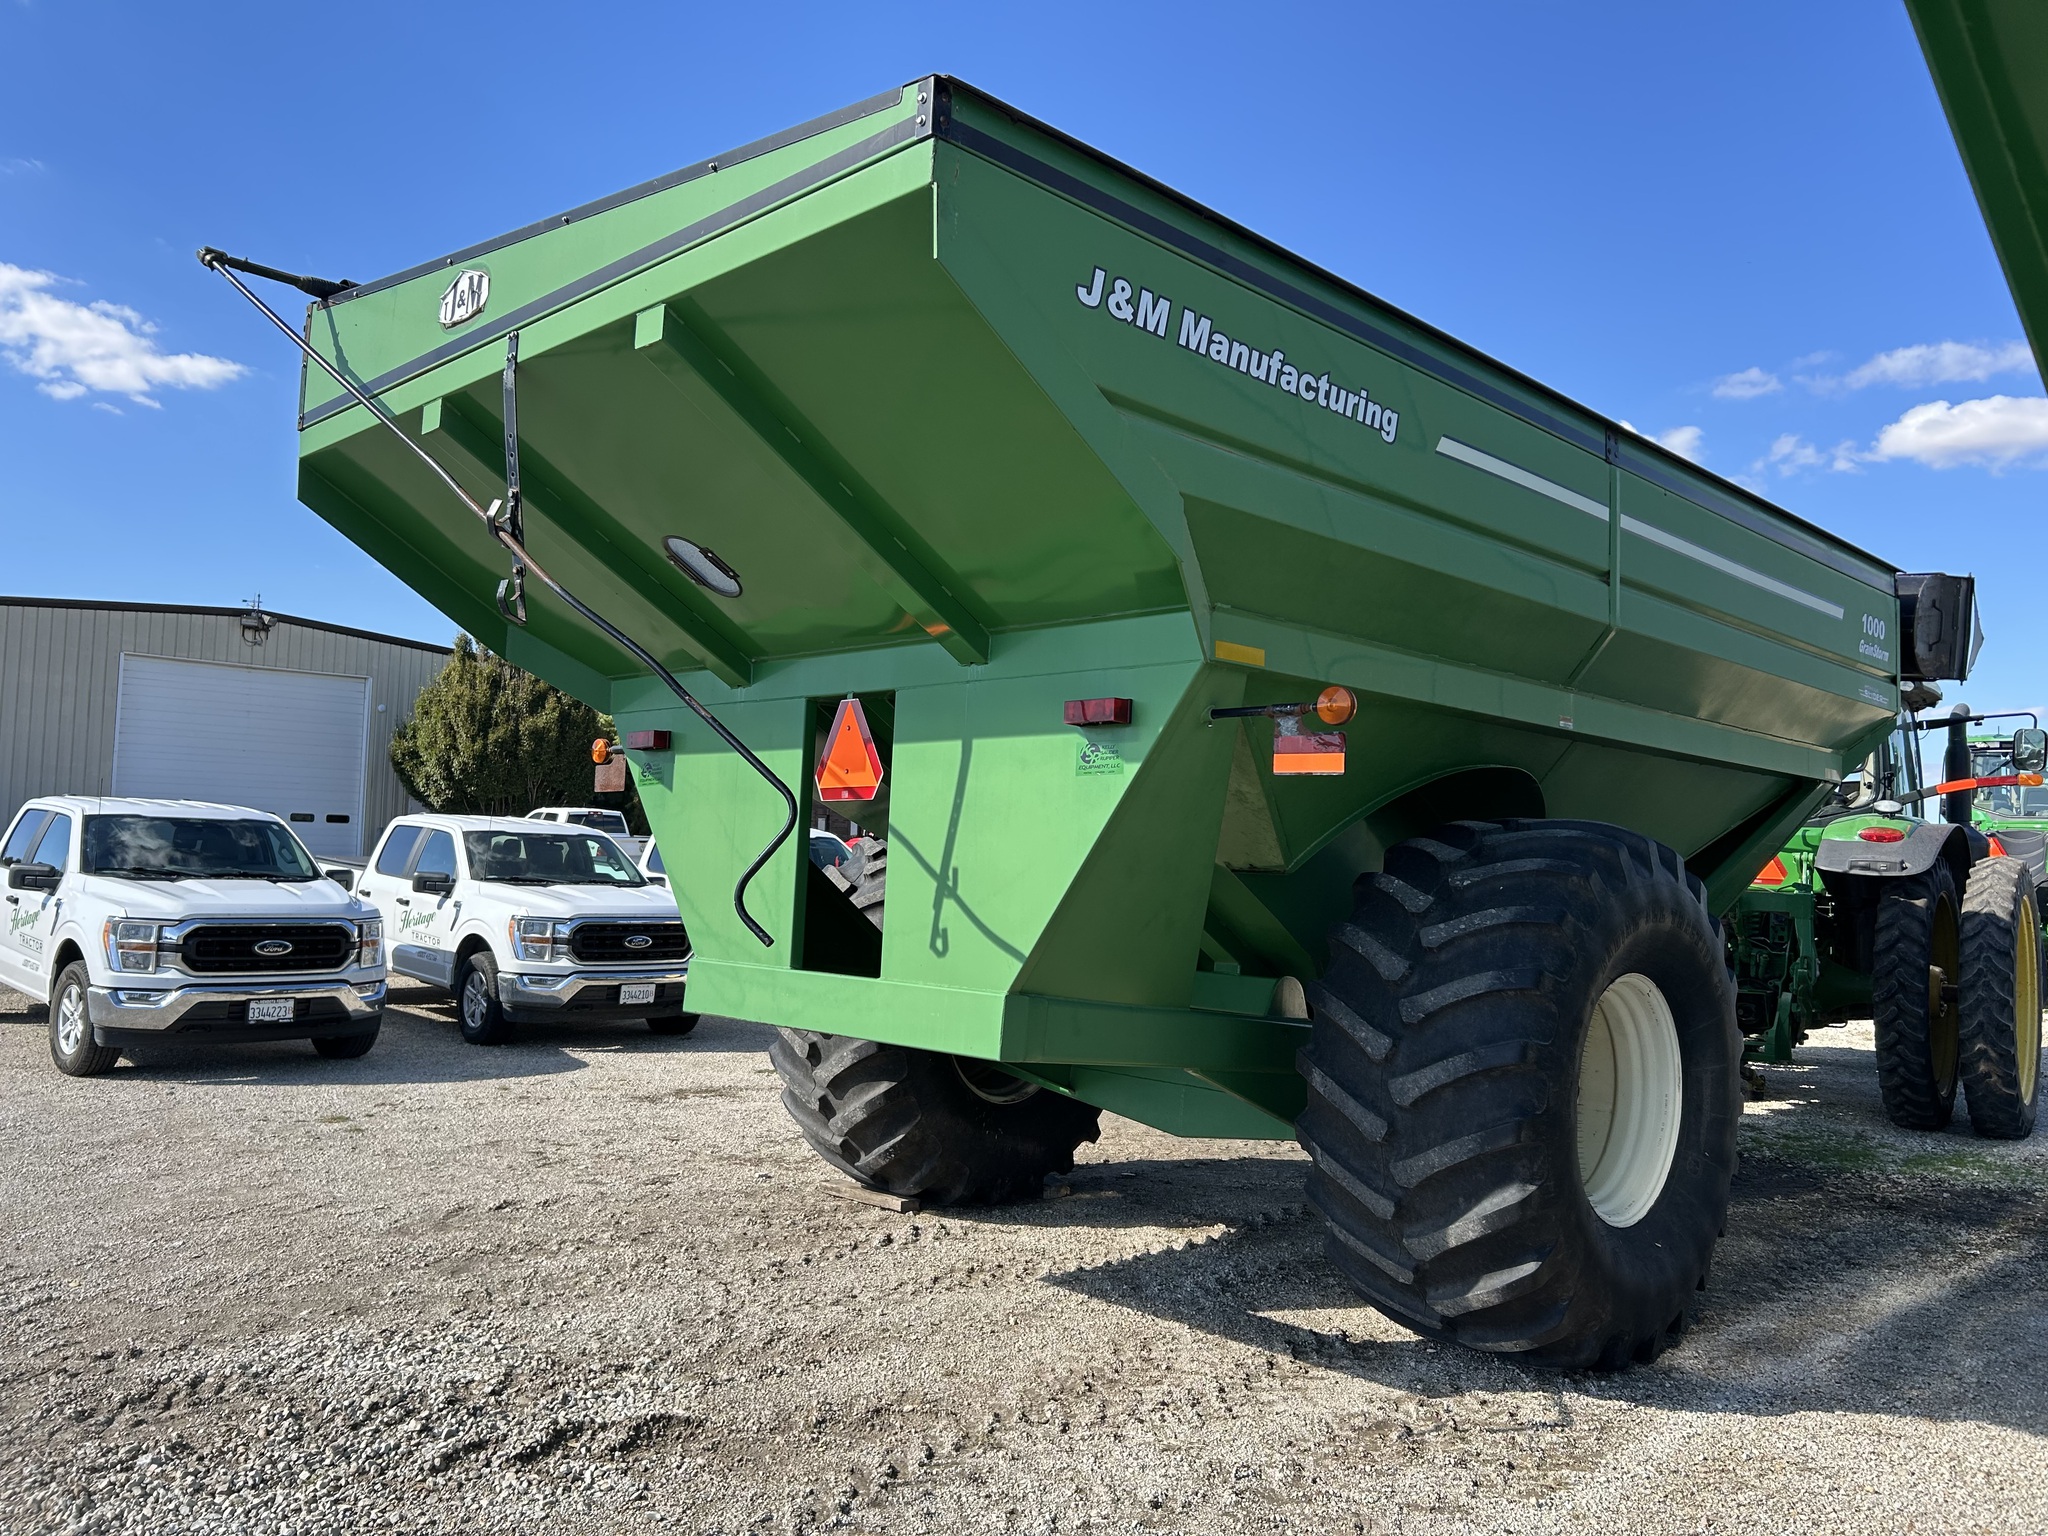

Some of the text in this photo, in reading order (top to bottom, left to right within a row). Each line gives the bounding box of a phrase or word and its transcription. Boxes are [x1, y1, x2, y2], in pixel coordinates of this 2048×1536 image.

[444, 273, 485, 321] J&M
[1075, 265, 1400, 444] J&M Manufacturing
[1862, 613, 1886, 640] 1000
[9, 905, 41, 936] Heritage
[399, 908, 437, 933] Heritage
[19, 933, 43, 952] TRACTOR
[263, 943, 284, 952] Ford
[411, 931, 441, 946] TRACTOR
[631, 938, 646, 946] Ford
